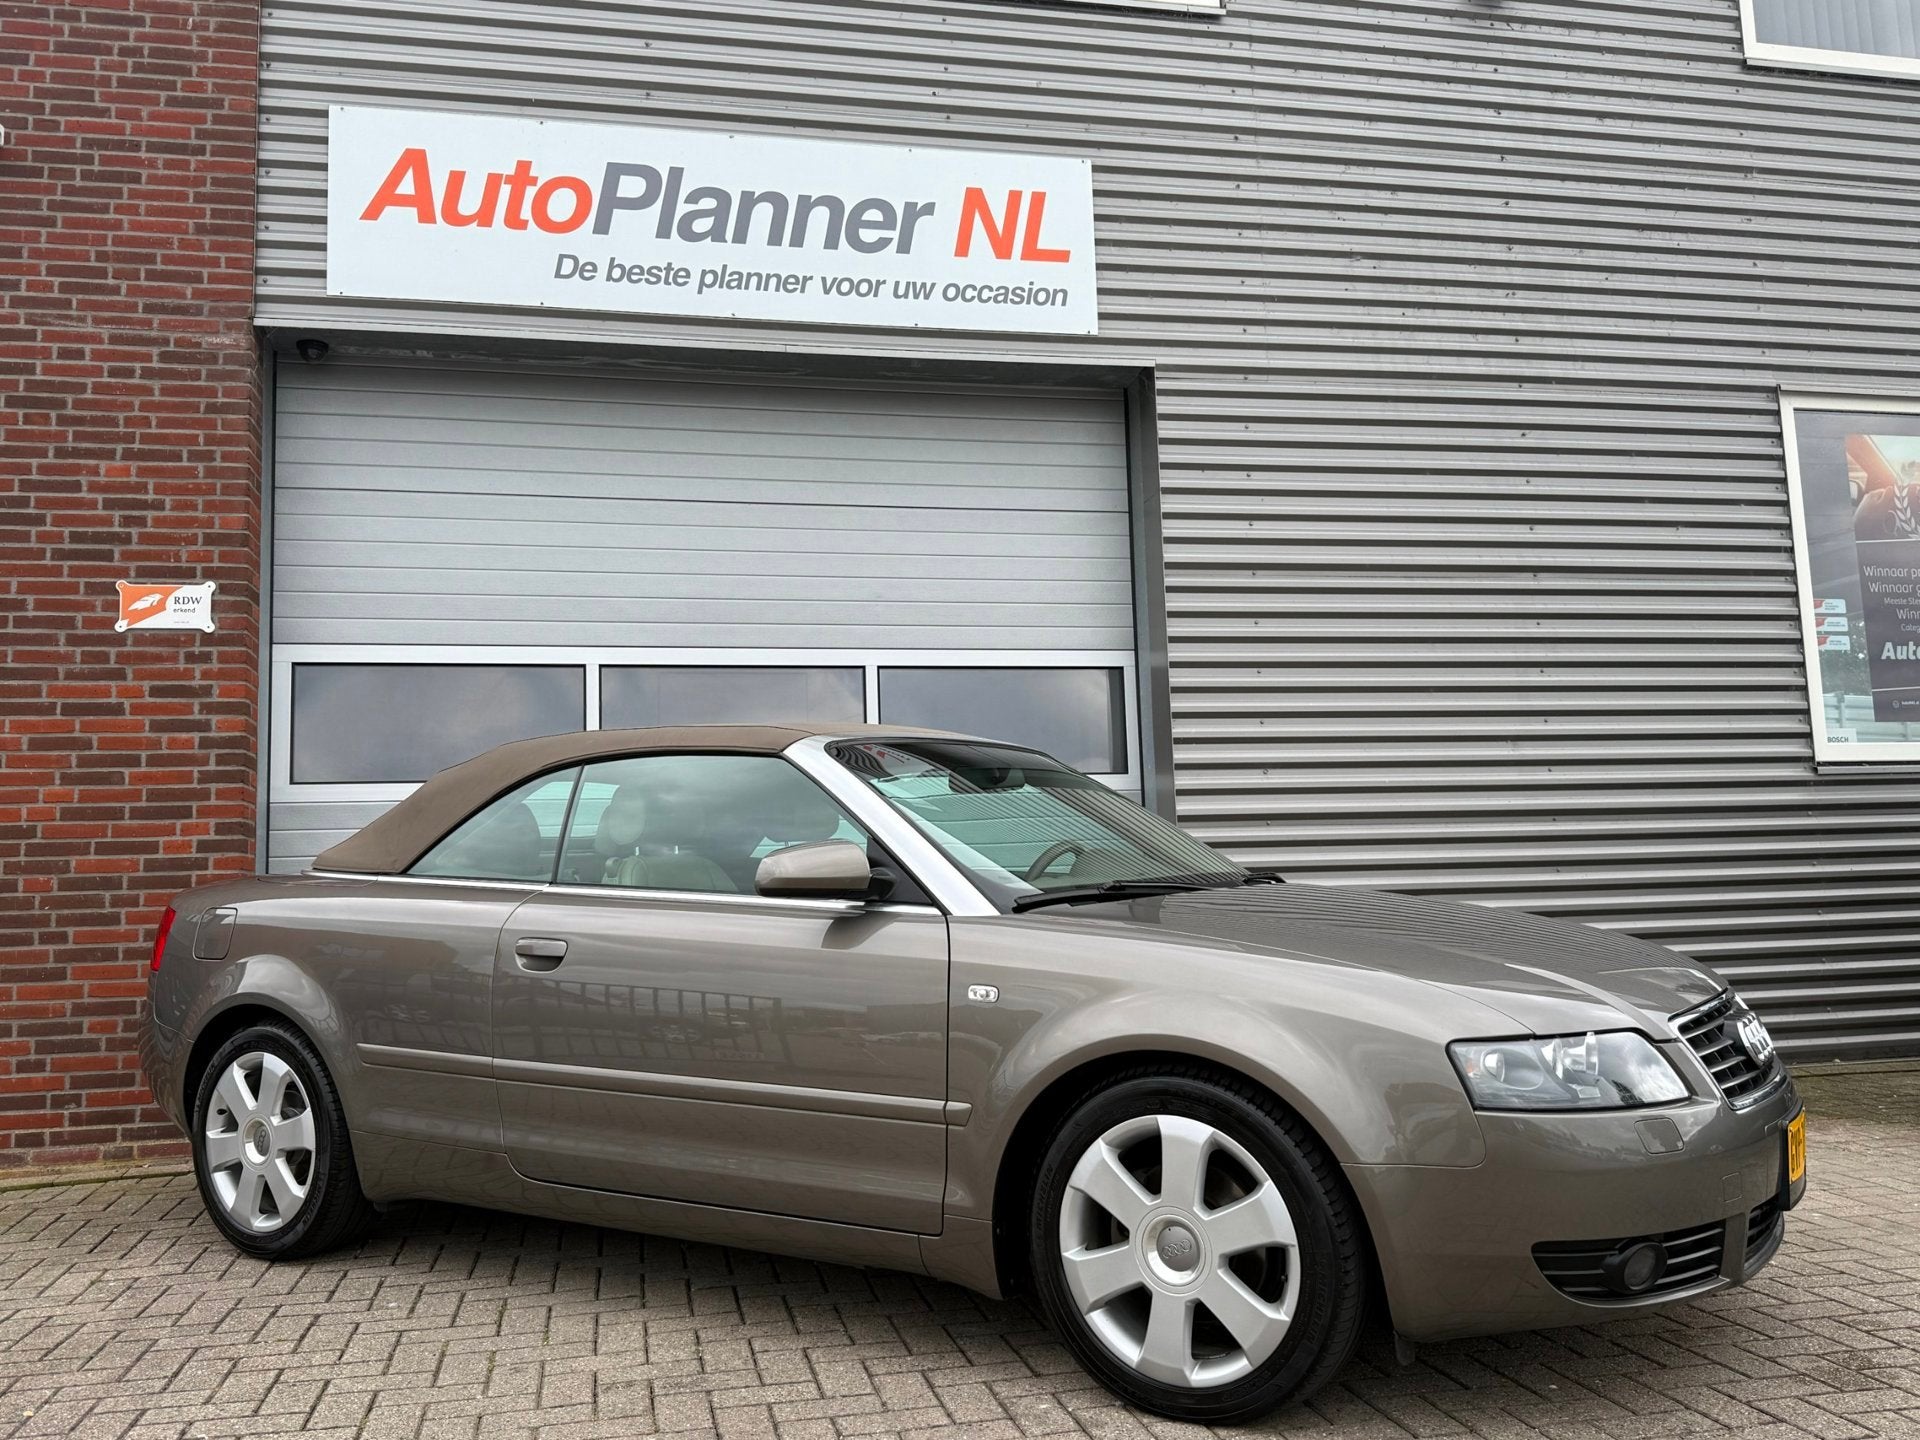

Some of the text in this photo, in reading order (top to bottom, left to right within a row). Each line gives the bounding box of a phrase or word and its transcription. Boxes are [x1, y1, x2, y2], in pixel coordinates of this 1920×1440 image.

[360, 148, 1071, 264] AutoPlanner NL
[554, 253, 1068, 307] De beste planner voor uw occasion
[1863, 565, 1909, 577] Winnaar
[1868, 581, 1914, 593] Winnaar
[174, 596, 202, 605] RDW
